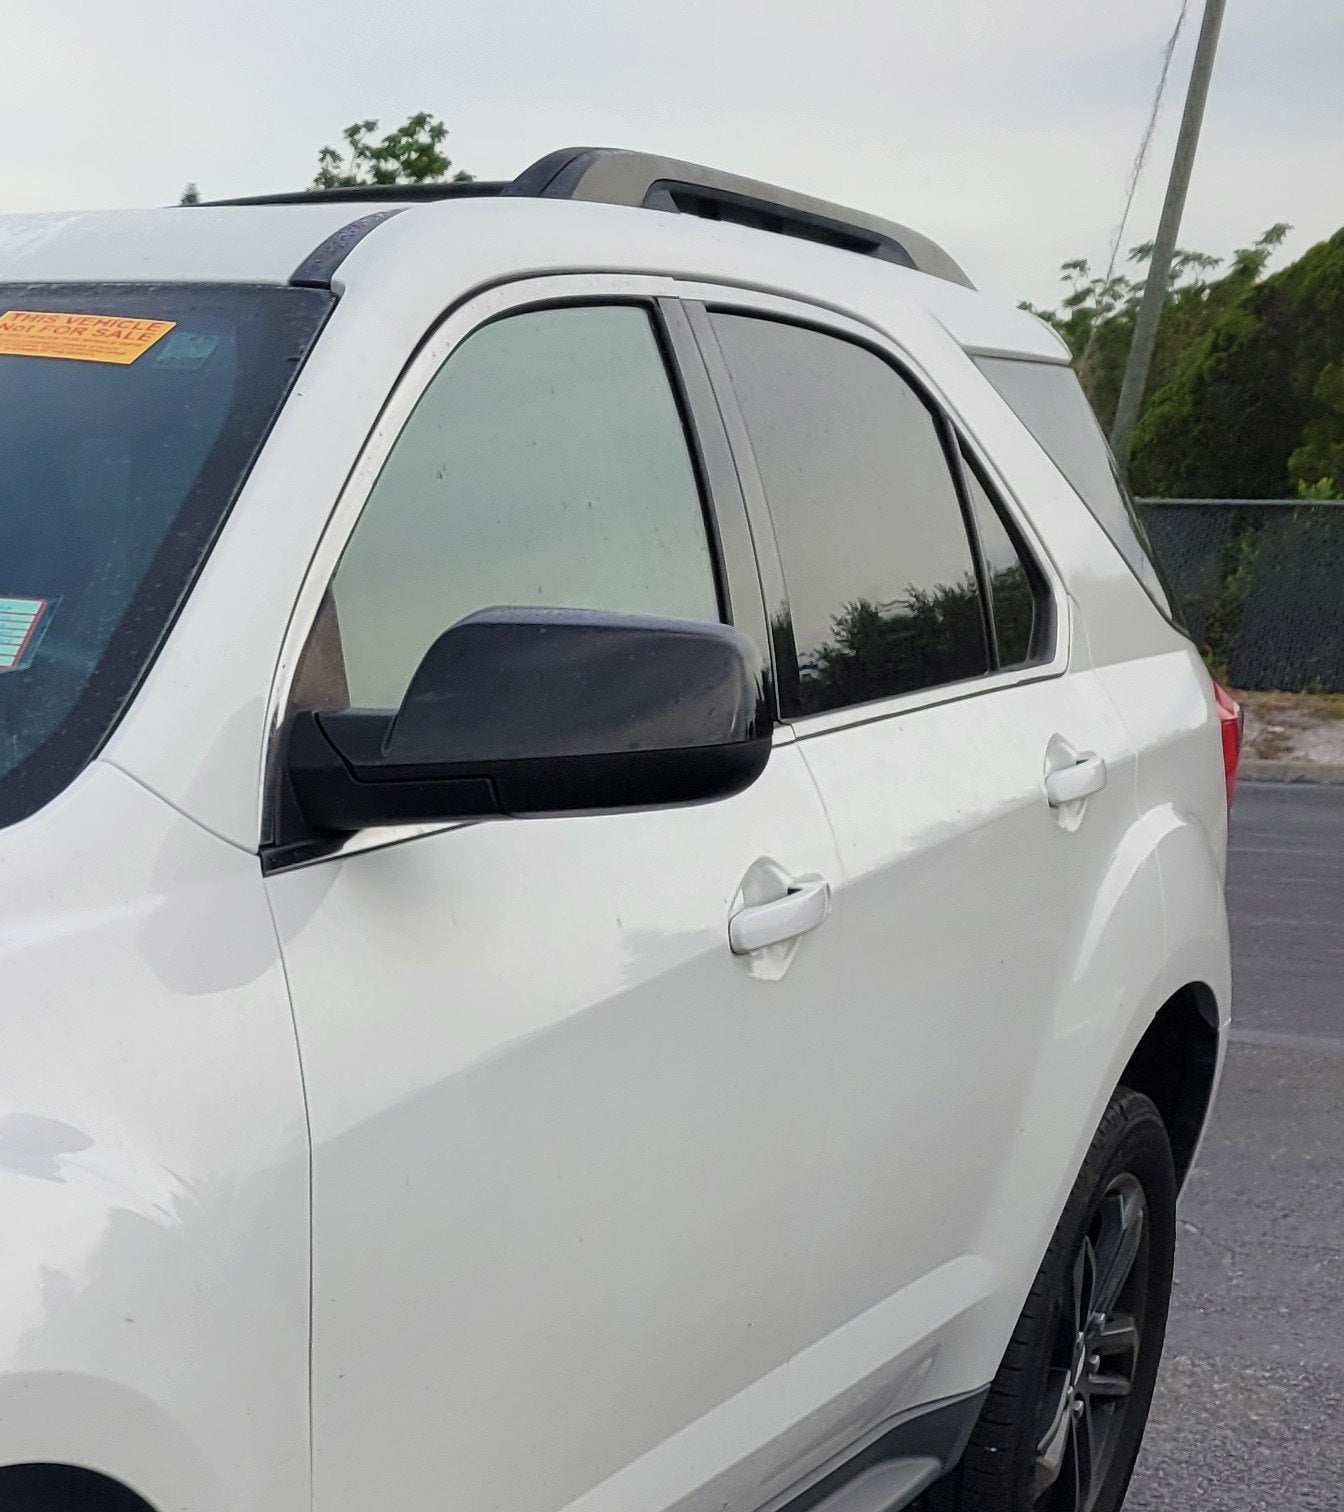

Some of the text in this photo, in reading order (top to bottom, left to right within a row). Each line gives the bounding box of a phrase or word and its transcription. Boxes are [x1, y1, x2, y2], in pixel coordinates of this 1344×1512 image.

[11, 312, 165, 332] THIS VEHICLE
[38, 324, 89, 337] FOR
[91, 327, 155, 342] SALE
